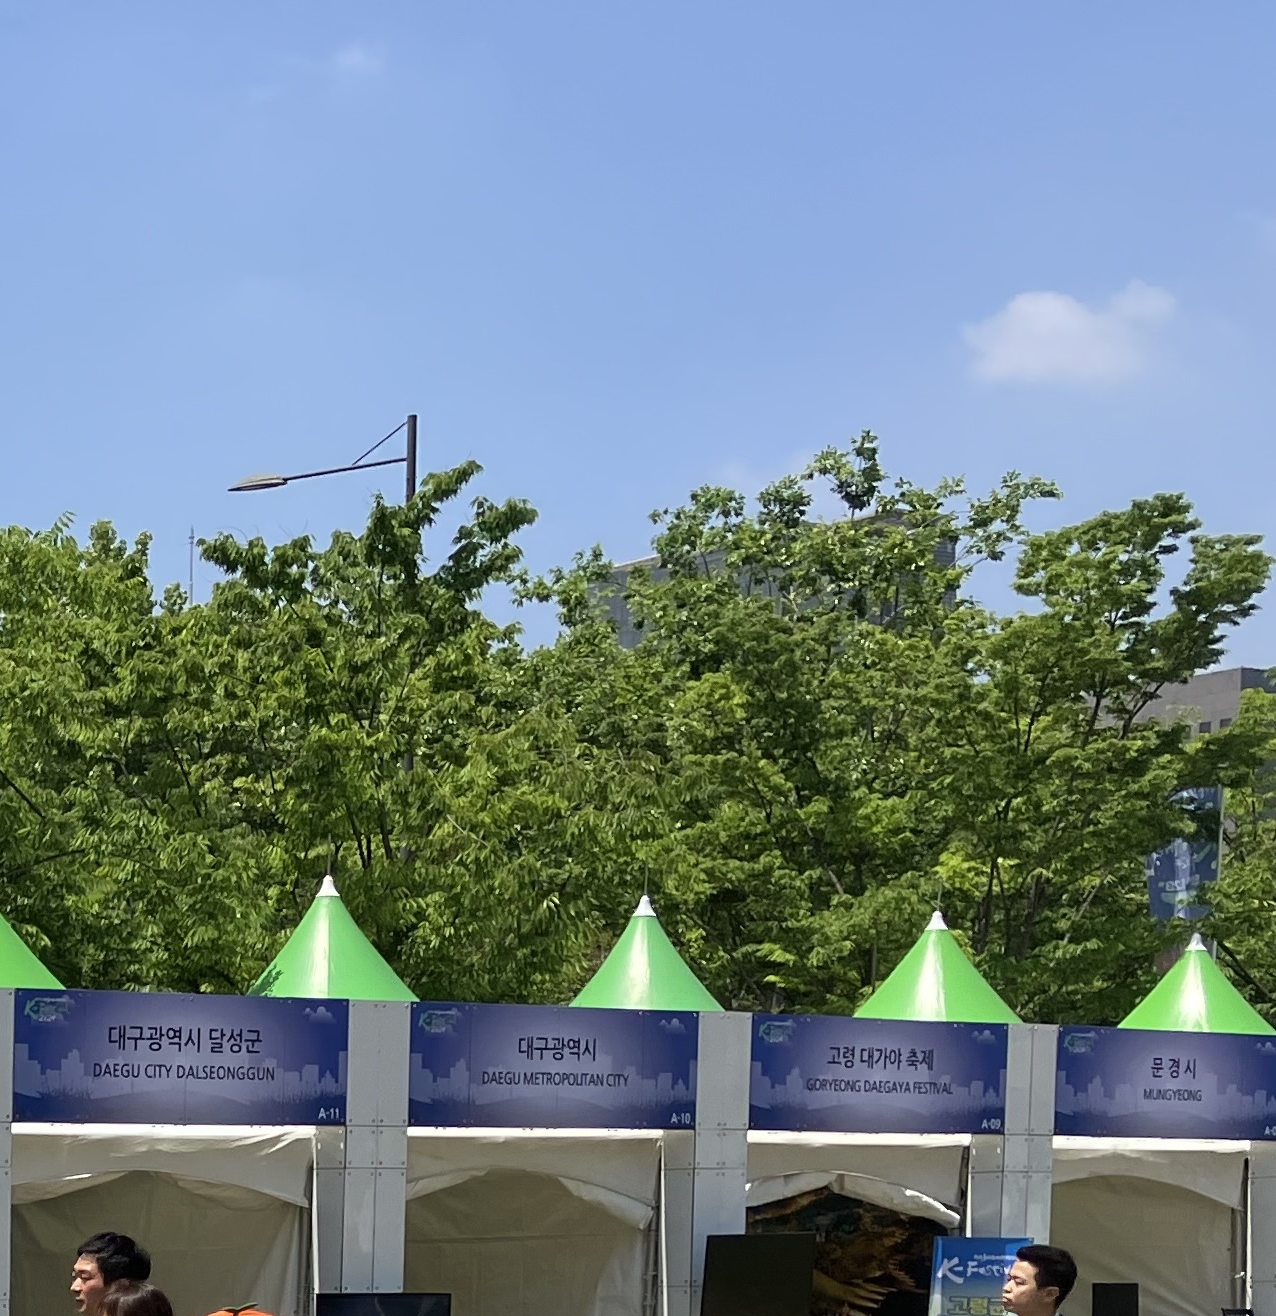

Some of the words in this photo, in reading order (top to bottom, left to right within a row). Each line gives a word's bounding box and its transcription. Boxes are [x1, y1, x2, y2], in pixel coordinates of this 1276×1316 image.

[108, 1024, 201, 1054] 대구광역시
[209, 1026, 263, 1054] 달성군
[518, 1036, 597, 1062] 대구광역시
[826, 1045, 855, 1068] 고령
[860, 1046, 903, 1070] 대가야
[905, 1048, 934, 1072] 축제
[92, 1062, 141, 1079] DAEGU
[144, 1063, 173, 1080] CITY
[176, 1064, 276, 1082] DALSEONGGUN
[481, 1071, 521, 1086] DAEGU
[523, 1072, 604, 1088] METROPOLITAN
[607, 1073, 630, 1088] CITY
[806, 1077, 861, 1093] GORYEONG
[863, 1079, 911, 1095] DAEGAYA
[913, 1080, 953, 1095] FESTIVAL
[1143, 1088, 1202, 1102] MUNGYEONG
[318, 1107, 340, 1120] A-11
[670, 1112, 691, 1125] A-10
[981, 1117, 1001, 1130] A-09
